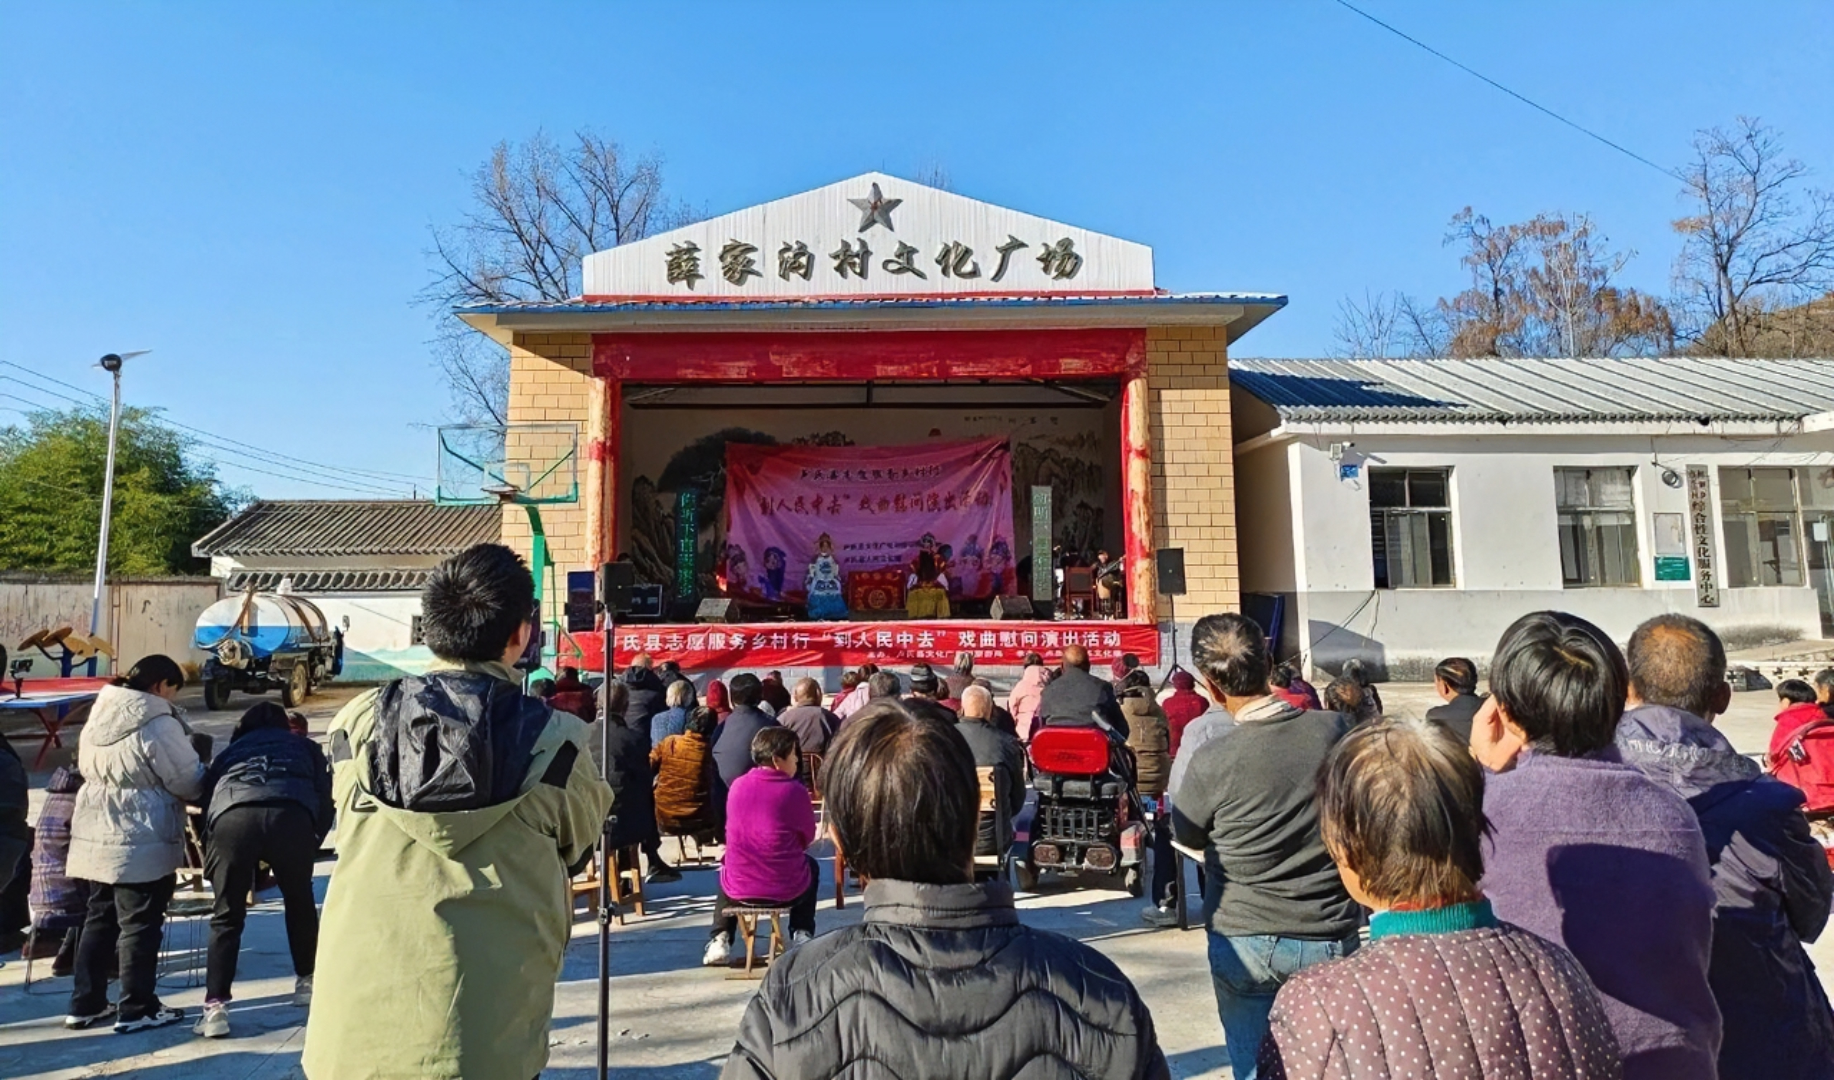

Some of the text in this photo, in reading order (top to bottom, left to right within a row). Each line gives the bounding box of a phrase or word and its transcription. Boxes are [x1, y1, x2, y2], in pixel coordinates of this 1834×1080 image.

[665, 234, 1084, 290] 薛家沟村文化广场
